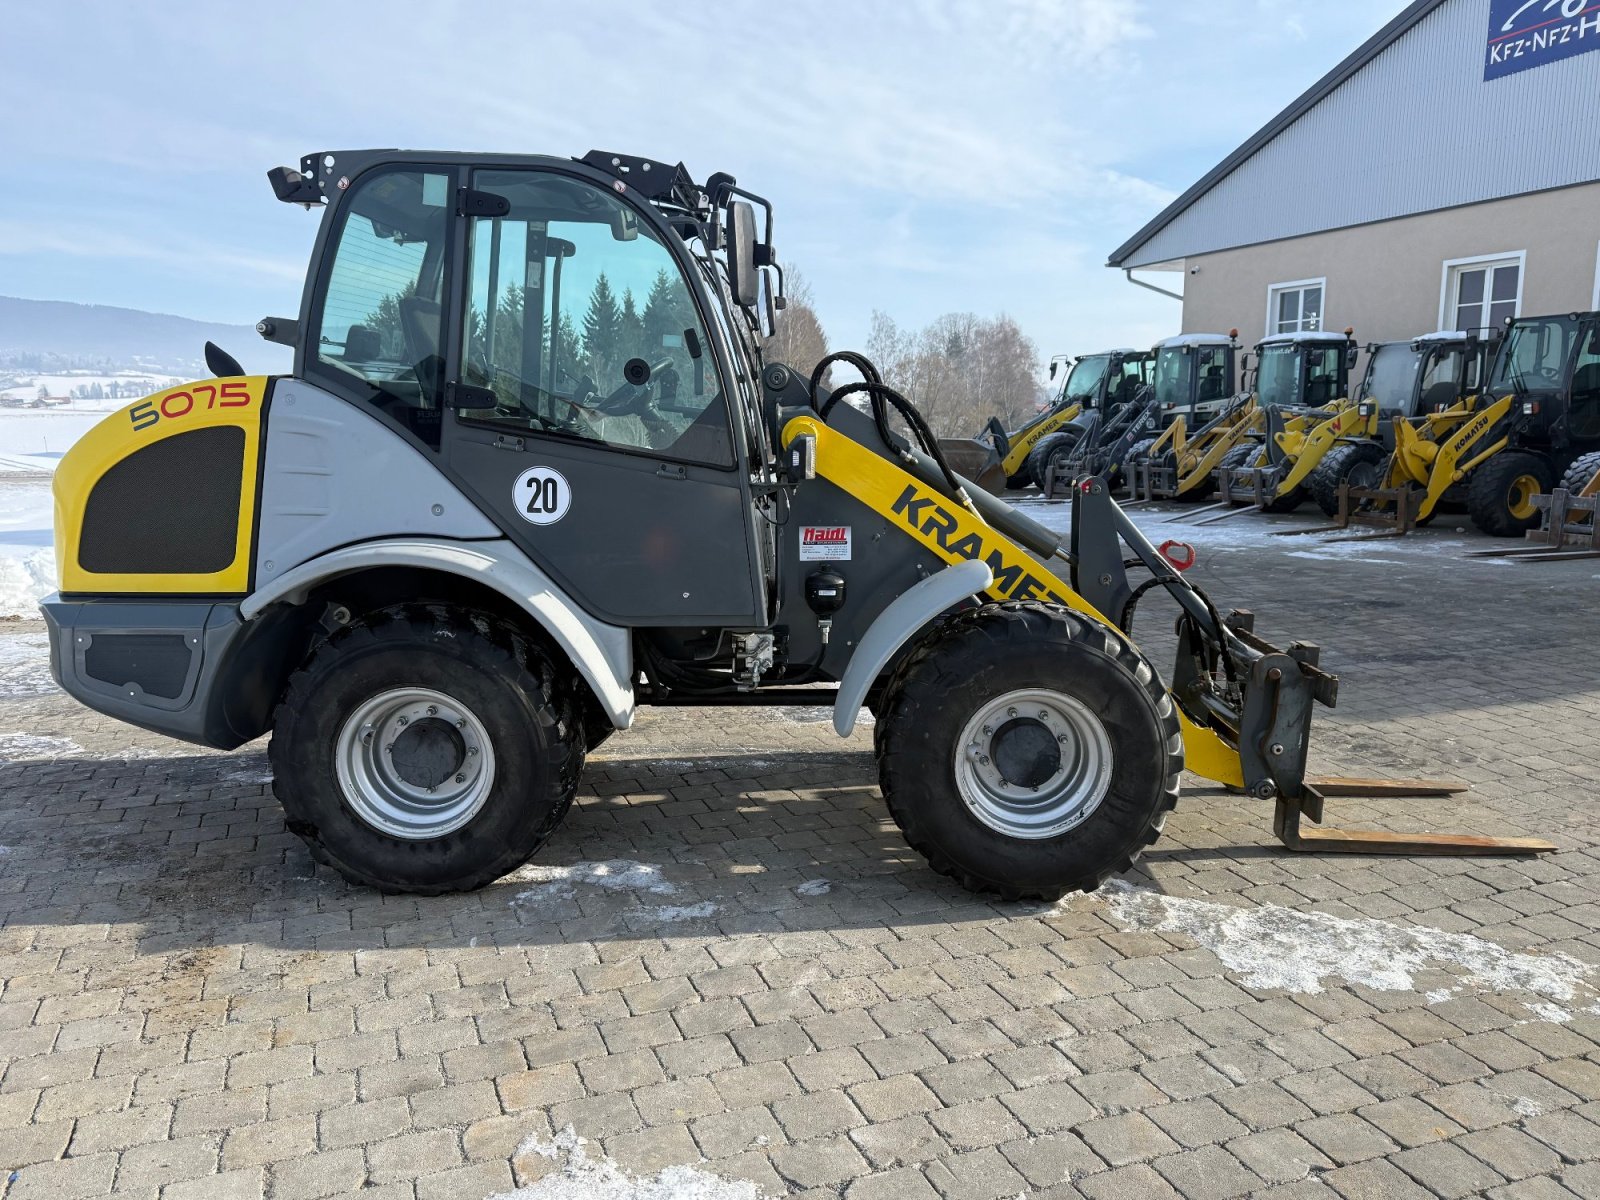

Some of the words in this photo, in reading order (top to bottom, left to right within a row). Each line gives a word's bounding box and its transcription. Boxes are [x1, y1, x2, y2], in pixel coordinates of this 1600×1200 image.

[129, 383, 251, 431] 5075
[1131, 410, 1151, 433] TEREX
[1027, 419, 1059, 446] KRAMER
[1454, 415, 1489, 452] KOMATSU
[526, 477, 557, 513] 20
[803, 527, 846, 541] Haidl
[891, 484, 1069, 607] KRAME
